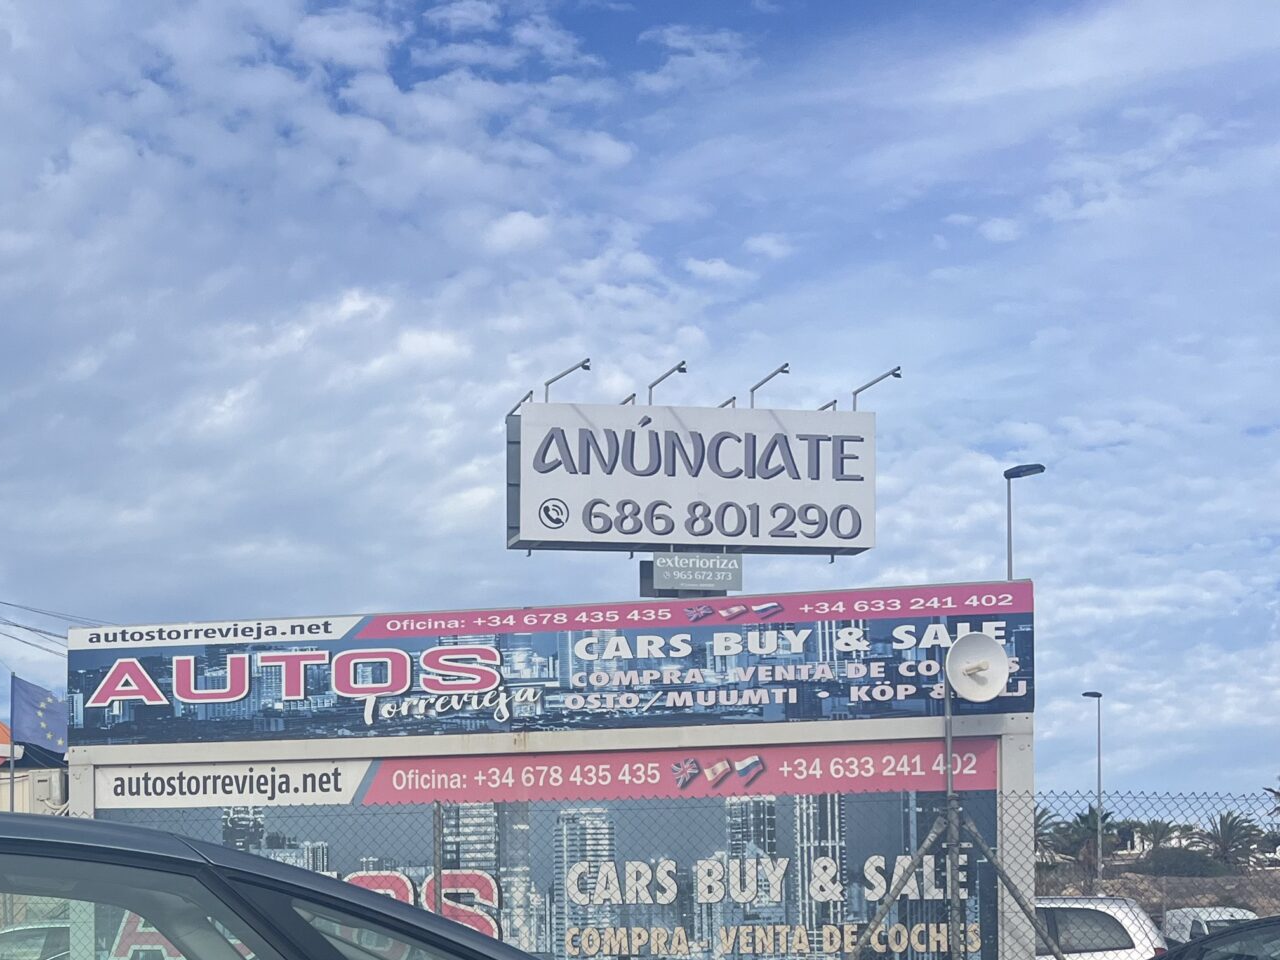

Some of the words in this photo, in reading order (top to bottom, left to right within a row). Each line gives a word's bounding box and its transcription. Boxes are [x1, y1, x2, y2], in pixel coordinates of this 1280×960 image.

[532, 415, 864, 481] ANÚNCIATE
[582, 498, 675, 536] 686
[684, 500, 760, 538] 801
[768, 502, 862, 539] 290
[656, 555, 739, 569] exterioriza
[673, 570, 693, 580] 965
[694, 571, 713, 580] 672
[714, 571, 732, 580] 373
[799, 601, 846, 615] +34
[852, 599, 903, 614] 633
[909, 596, 957, 611] 241
[964, 593, 1014, 609] 402
[88, 619, 333, 644] autostorrevieja.net
[386, 616, 466, 632] Oficina:
[472, 614, 517, 630] +34
[523, 611, 568, 628] 678
[574, 611, 620, 625] 435
[626, 608, 672, 622] 435
[574, 632, 693, 661] CARS
[713, 628, 813, 656] BUY
[834, 626, 870, 653] &
[84, 645, 505, 708] AUTOS
[571, 667, 705, 688] COMPRA
[734, 662, 834, 683] VENTA
[846, 661, 885, 679] DE
[354, 685, 544, 726] Torrevieja
[564, 687, 797, 711] OSTO/MUUMTI
[850, 681, 917, 702] KÖP
[392, 768, 467, 792] Oficina:
[473, 767, 515, 788] +34
[521, 764, 563, 787] 678
[569, 763, 612, 785] 435
[617, 762, 661, 784] 435
[778, 757, 822, 780] +34
[829, 756, 875, 778] 633
[881, 754, 926, 777] 241
[113, 767, 342, 800] autostorrevieja.net
[566, 858, 678, 906] CARS
[696, 857, 790, 904] BUY
[809, 856, 844, 901] &
[565, 926, 690, 956] COMPRA
[719, 925, 810, 954] VENTA
[822, 924, 857, 953] DE
